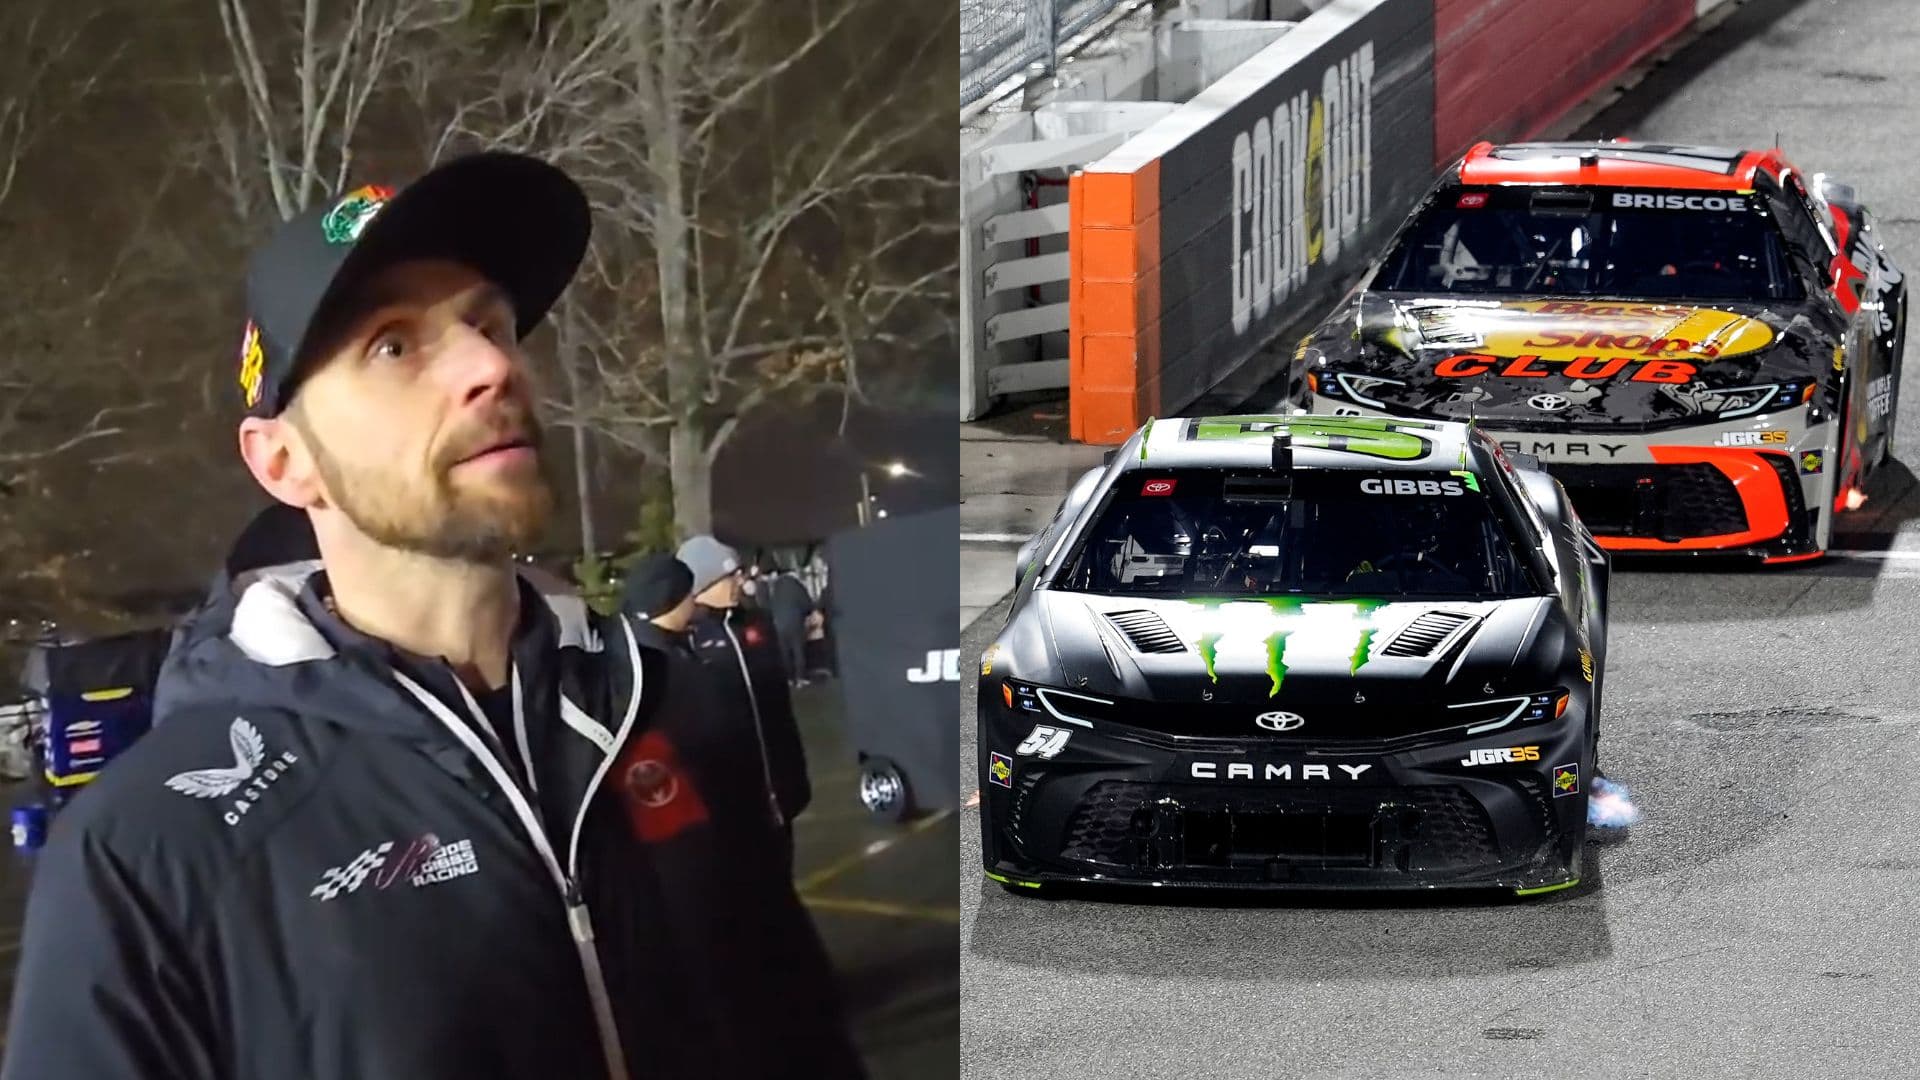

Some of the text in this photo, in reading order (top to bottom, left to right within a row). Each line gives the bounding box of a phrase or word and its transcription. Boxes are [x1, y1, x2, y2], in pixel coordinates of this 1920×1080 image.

[1612, 193, 1747, 212] BRISCOE
[1432, 354, 1697, 384] CLUB
[1500, 441, 1628, 457] AMRY
[1360, 478, 1464, 497] GIBBS
[1016, 724, 1073, 760] 54
[1461, 746, 1540, 767] JGR35
[1191, 762, 1372, 780] CAMRY
[224, 751, 298, 826] CASTORE
[435, 839, 472, 859] JOE
[421, 850, 475, 874] GIBBS
[413, 860, 479, 887] RACING
